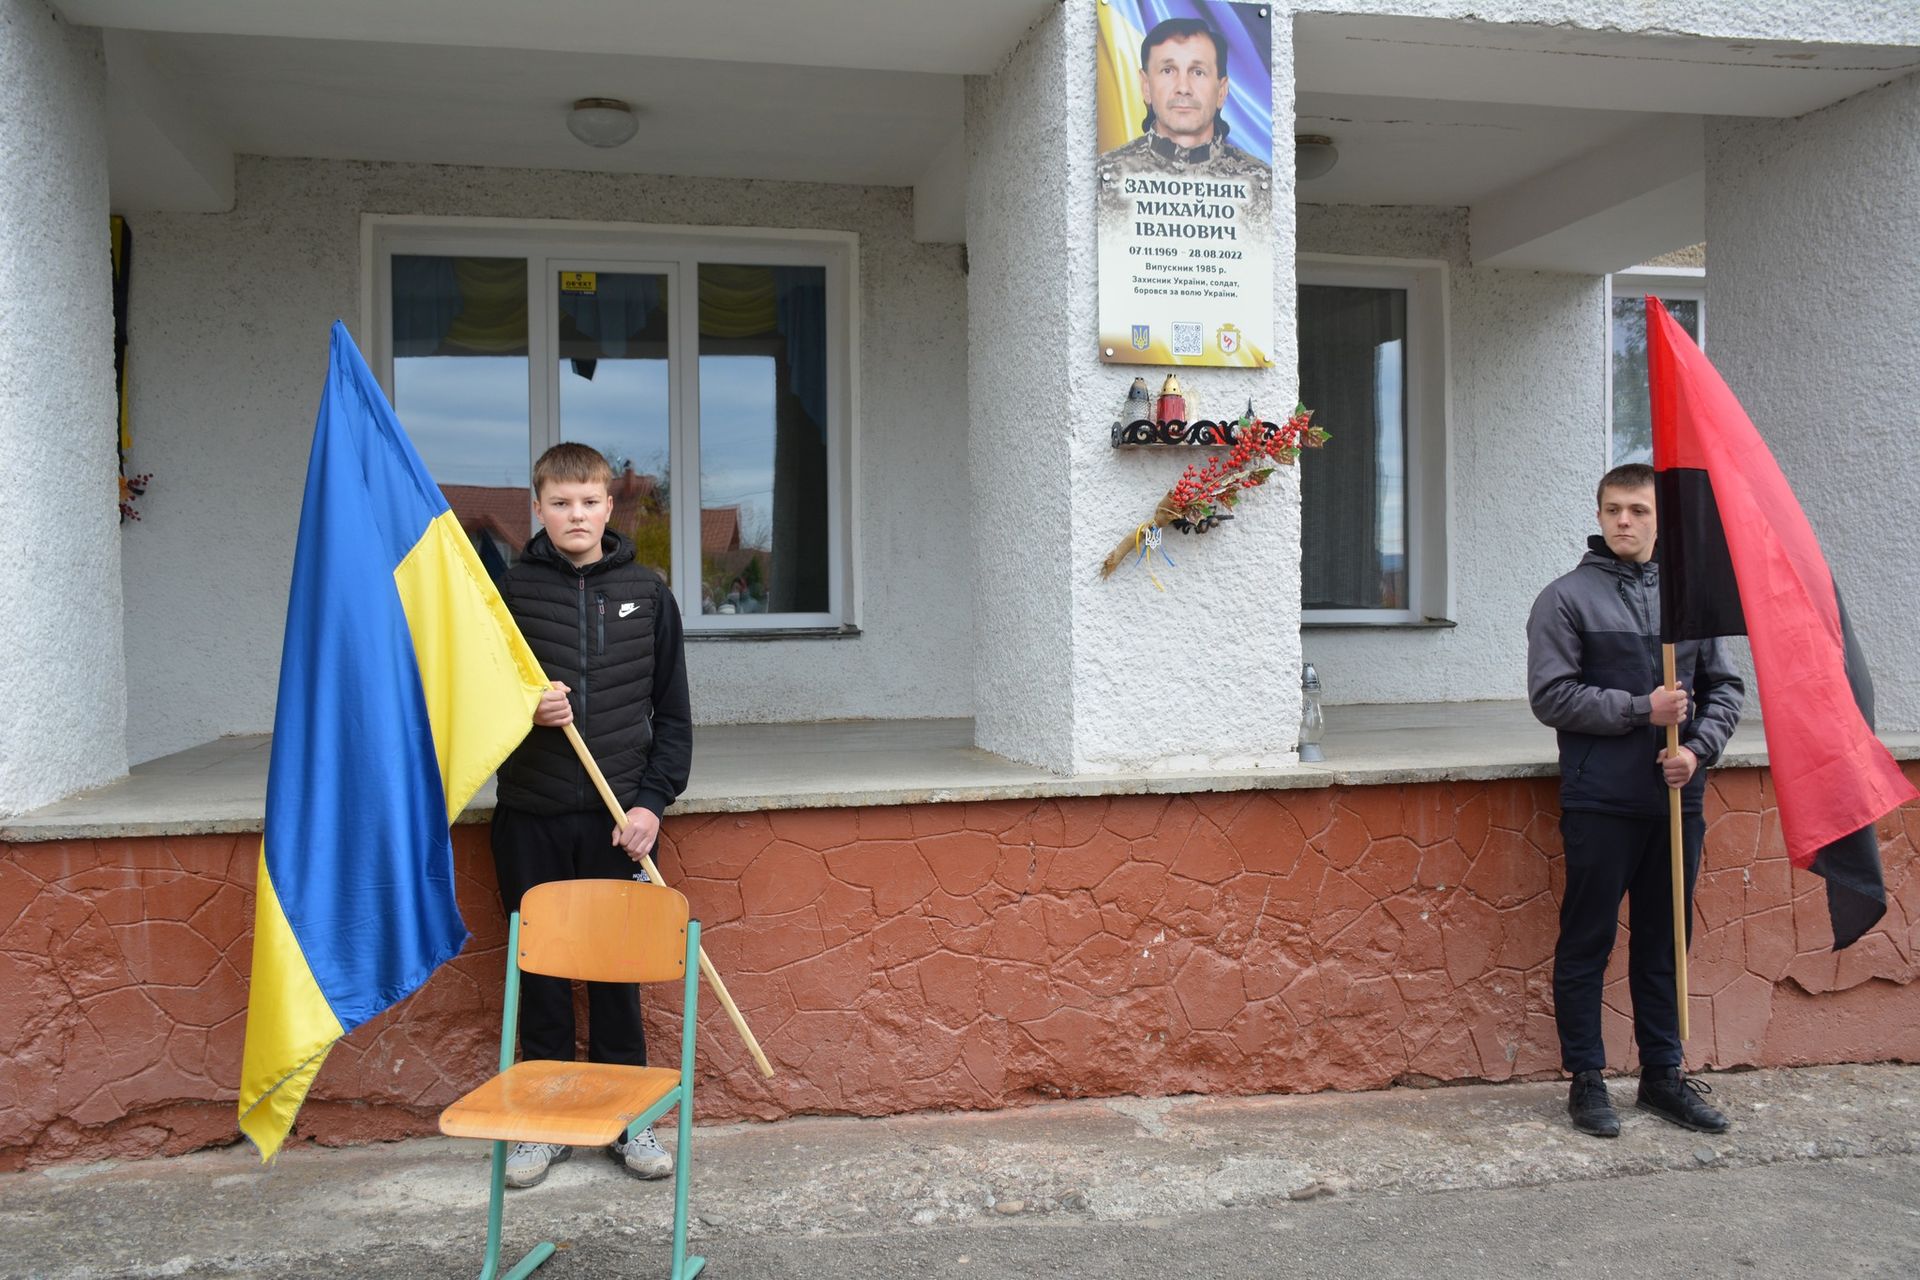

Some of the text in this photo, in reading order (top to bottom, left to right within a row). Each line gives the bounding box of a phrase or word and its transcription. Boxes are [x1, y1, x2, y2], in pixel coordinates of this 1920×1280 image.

[1125, 178, 1247, 199] ЗАМОРЕНЯК
[1136, 199, 1235, 219] МИХАЙЛО
[1135, 222, 1237, 240] ІВАНОВИЧ
[1129, 246, 1178, 257] 07.11.1969
[1188, 249, 1243, 260] 28.08.2022
[1145, 262, 1194, 273] Випускник
[1196, 264, 1217, 273] 1985
[1132, 275, 1172, 284] Захисник
[1210, 280, 1240, 288] солдат,
[1134, 286, 1168, 296] боровся
[1203, 289, 1238, 298] України.
